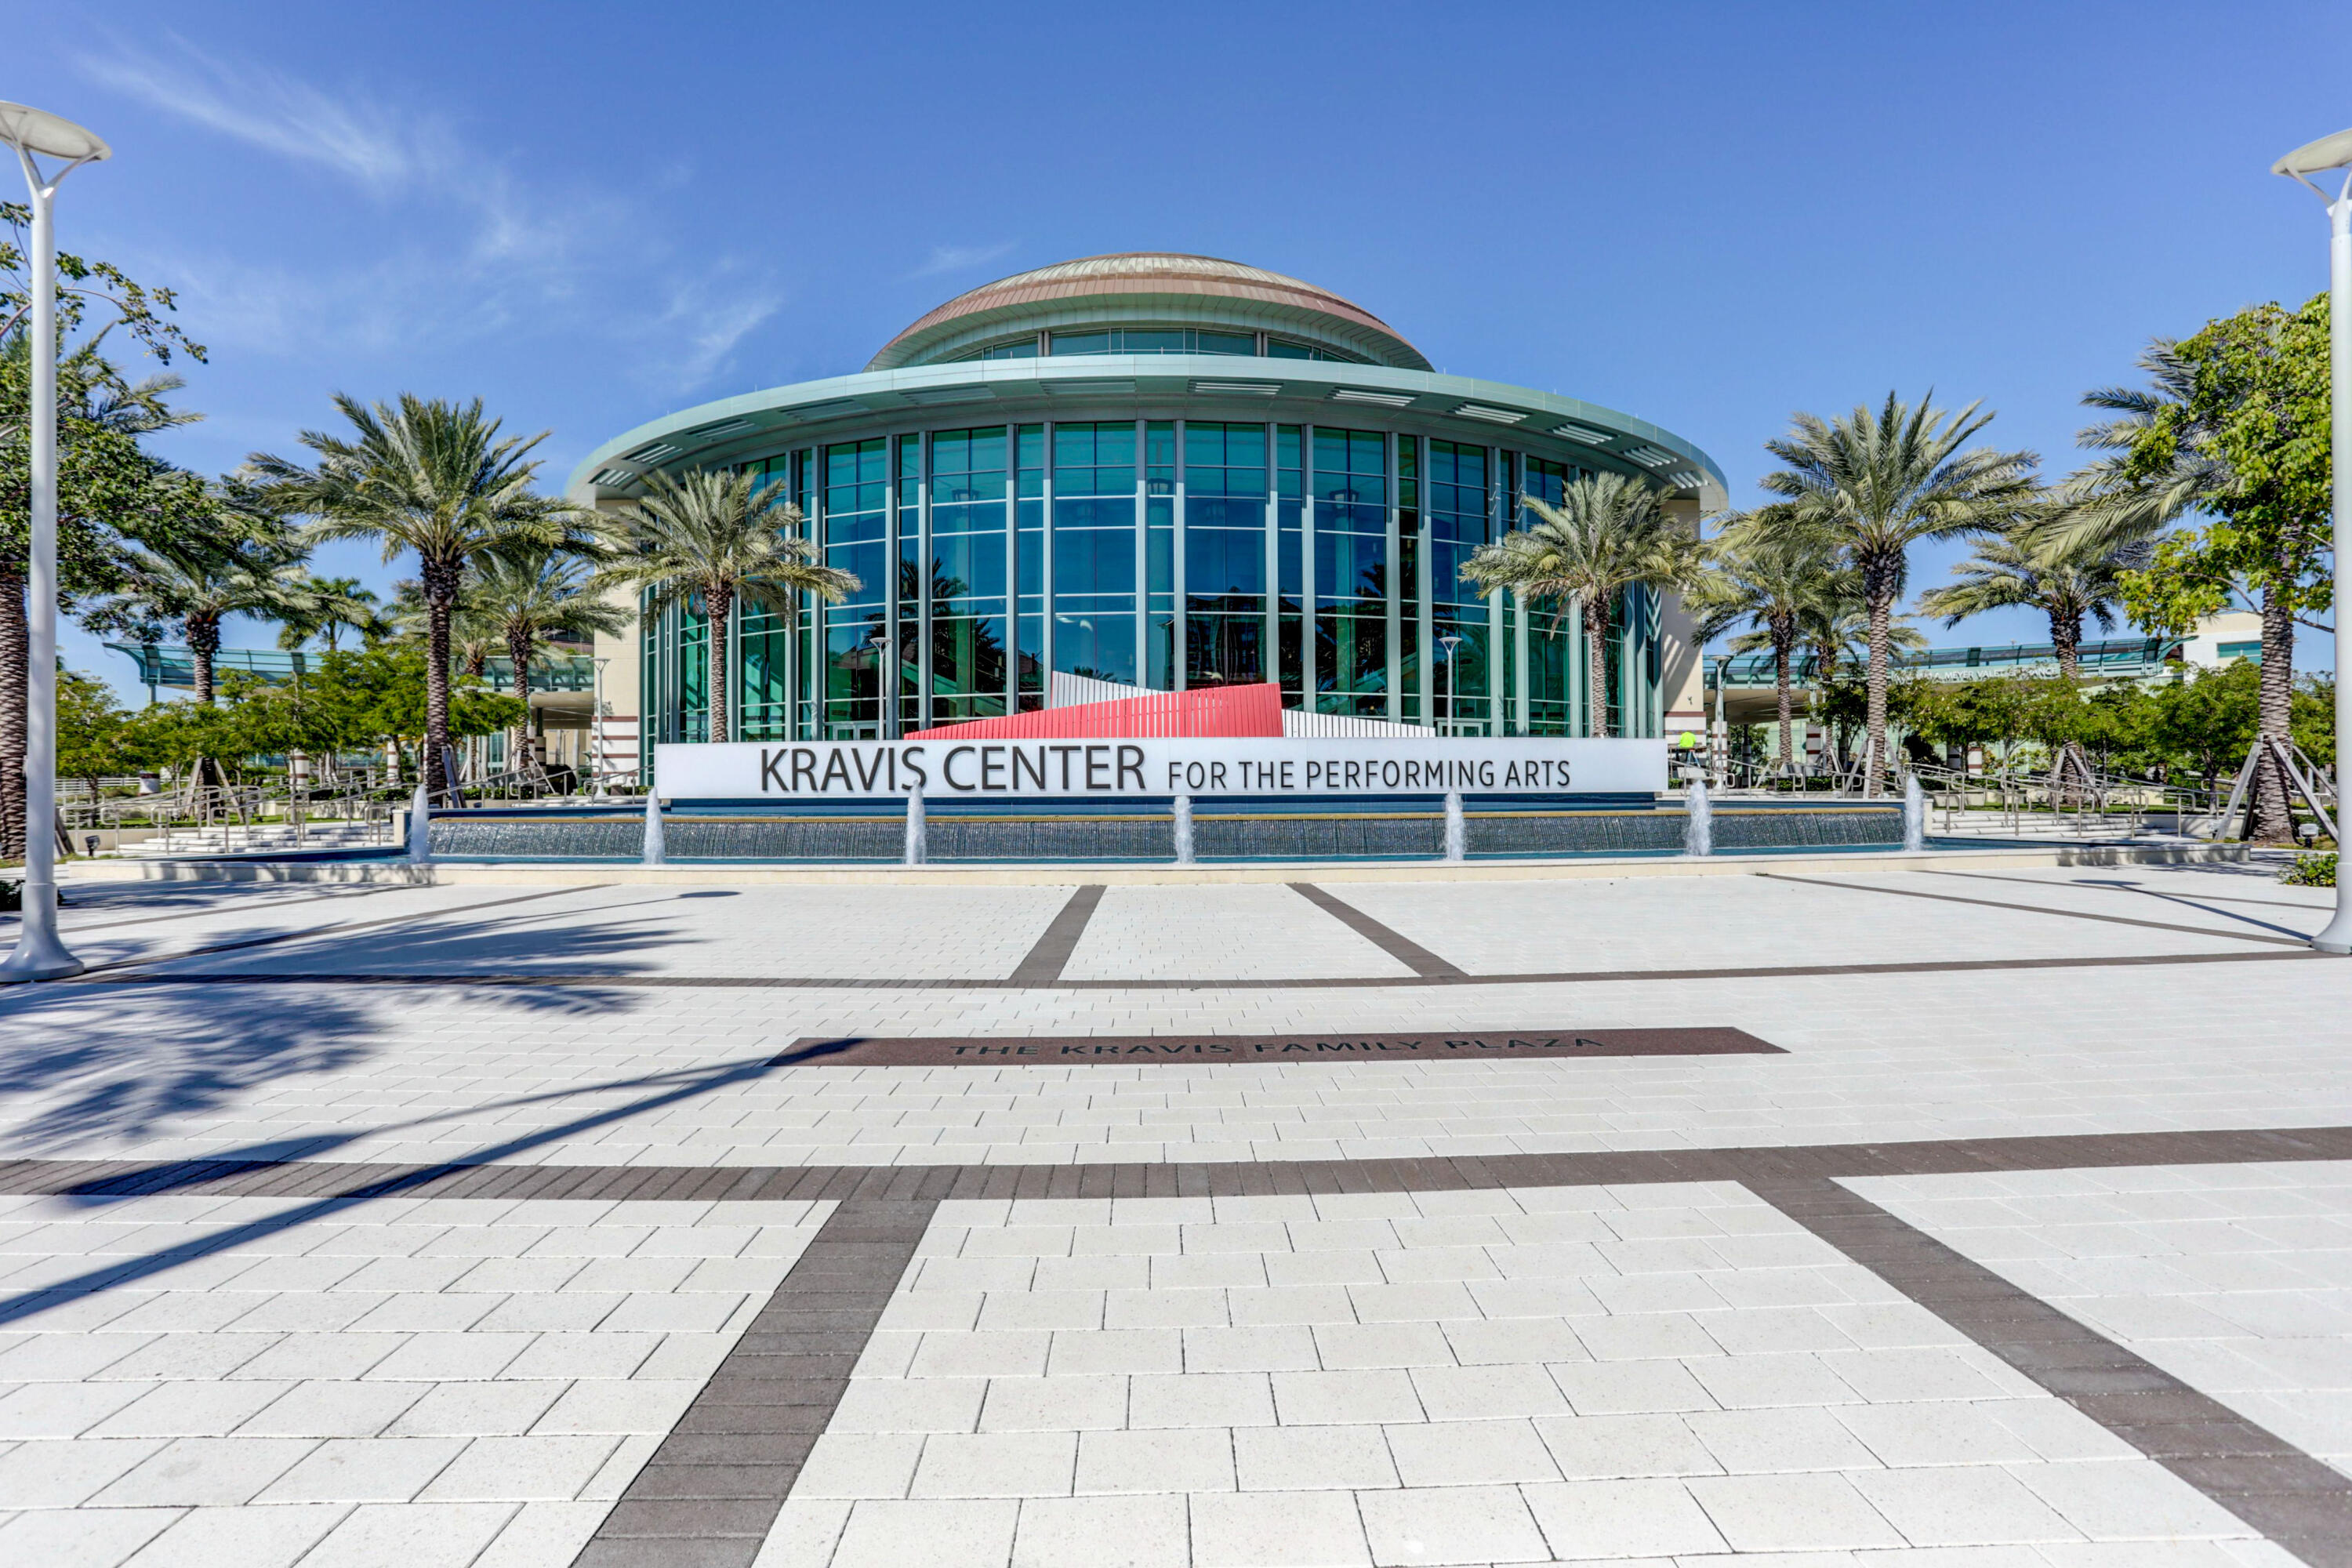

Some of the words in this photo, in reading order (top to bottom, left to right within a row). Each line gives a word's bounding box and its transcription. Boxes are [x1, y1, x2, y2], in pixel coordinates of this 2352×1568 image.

[1944, 670, 1973, 680] MEYER
[2008, 666, 2058, 677] EANCE
[761, 746, 927, 791] KRAVIS
[943, 745, 1146, 791] CENTER
[1169, 761, 1227, 789] FOR
[1237, 760, 1294, 789] THE
[1306, 760, 1494, 788] PERFORMING
[1504, 760, 1571, 787] ARTS
[949, 1046, 1040, 1056] THE
[1060, 1044, 1233, 1055] KRAVIS
[1254, 1040, 1423, 1053] FAMILY
[1443, 1038, 1605, 1051] PLAZA
